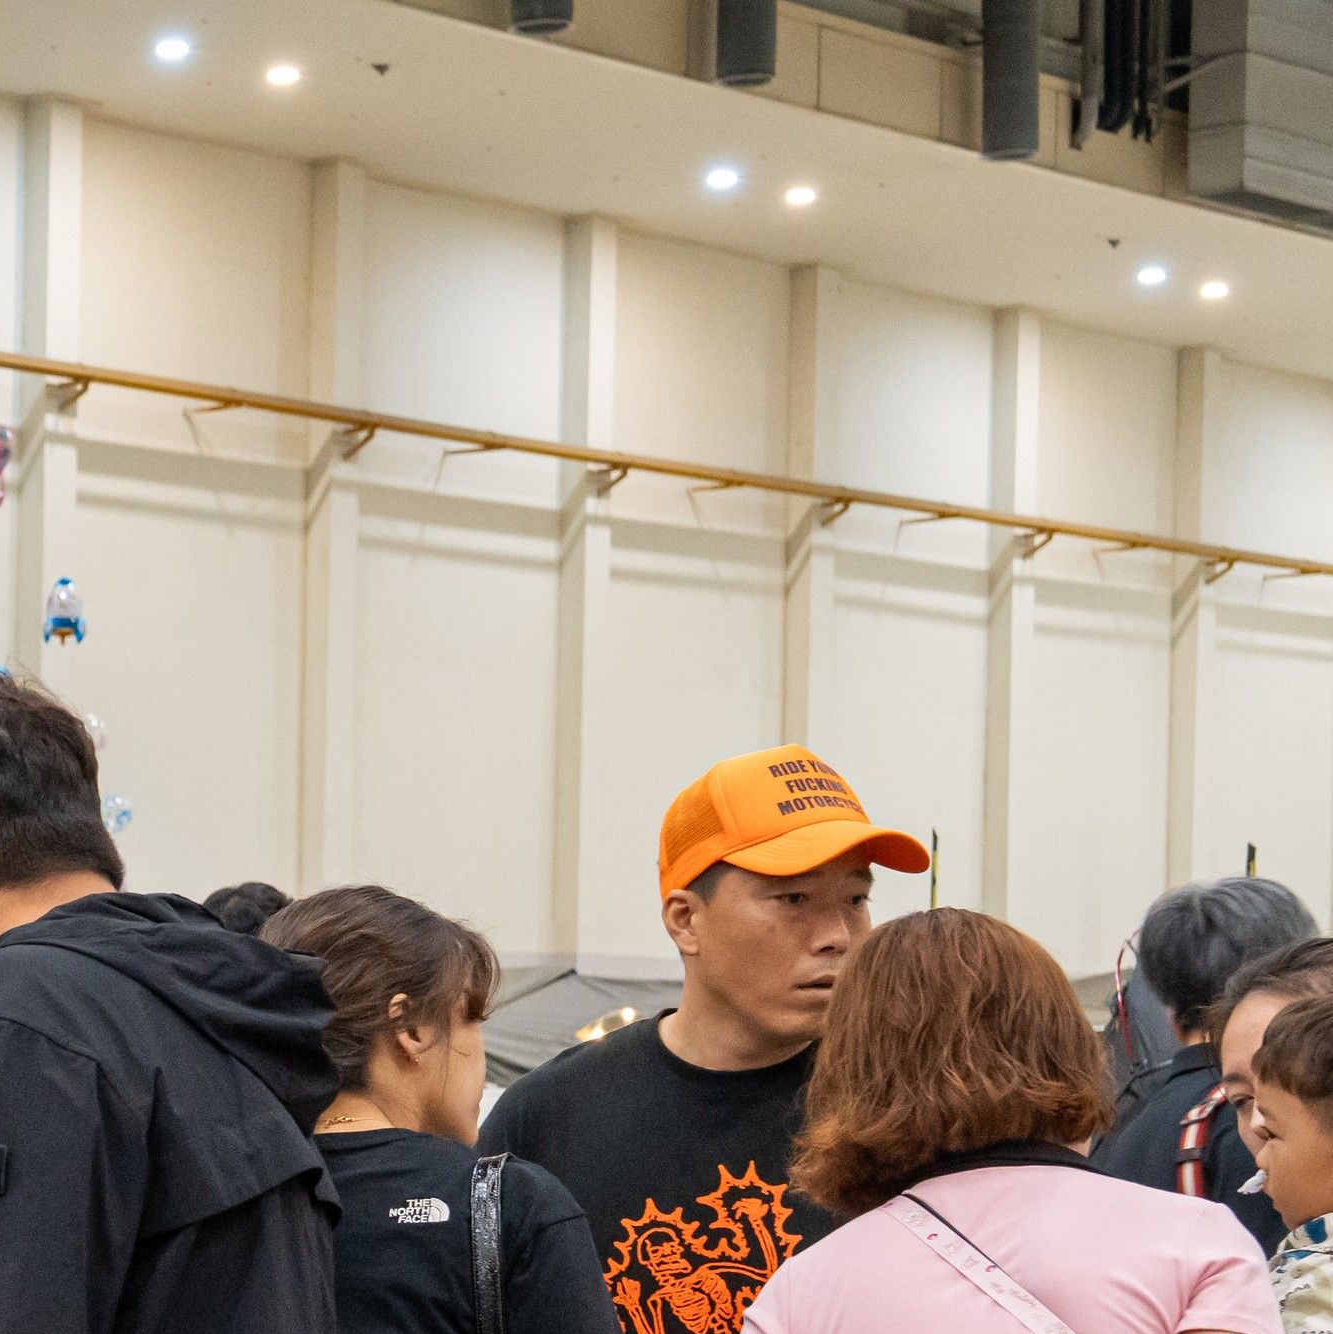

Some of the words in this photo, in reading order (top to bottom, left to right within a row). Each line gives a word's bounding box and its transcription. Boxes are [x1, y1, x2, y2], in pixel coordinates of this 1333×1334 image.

[768, 760, 808, 778] RIDE
[406, 1199, 431, 1207] THE
[389, 1207, 430, 1217] NORTH
[397, 1215, 429, 1223] FACE
